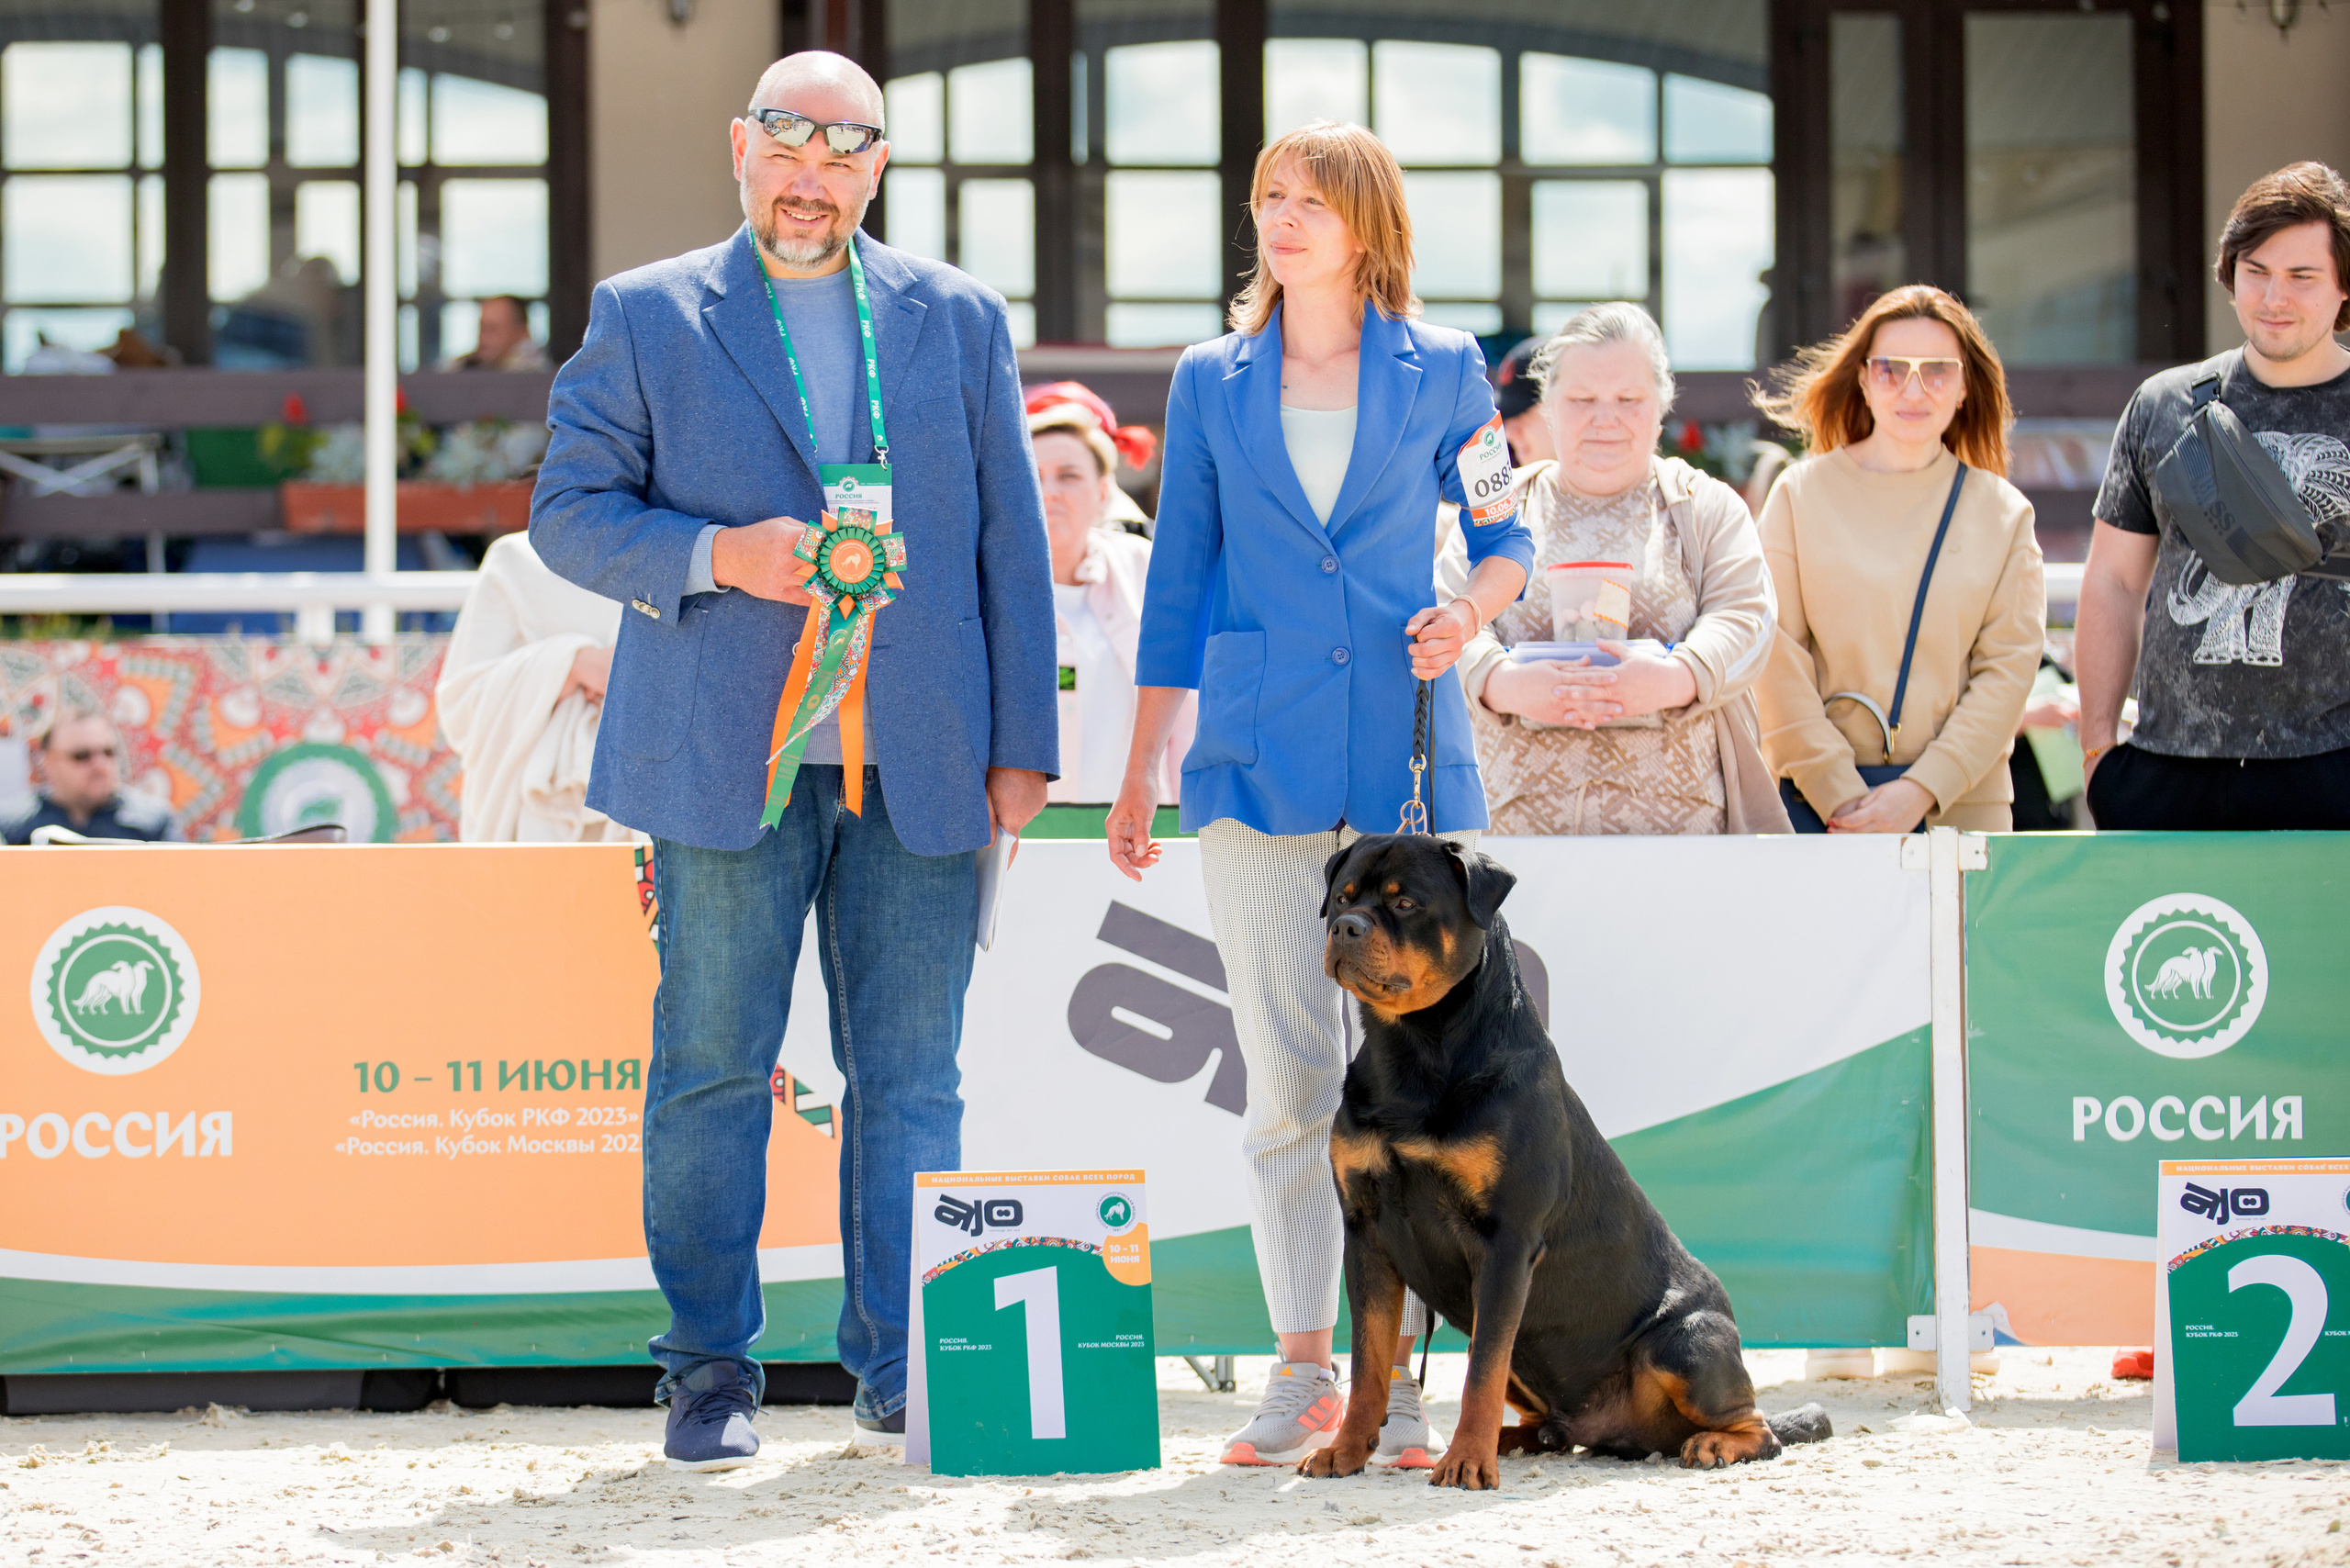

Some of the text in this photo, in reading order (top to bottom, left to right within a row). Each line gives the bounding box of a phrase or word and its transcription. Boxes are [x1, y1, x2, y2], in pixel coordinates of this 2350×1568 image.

[856, 283, 866, 300] РКФ
[861, 319, 871, 338] РКФ
[867, 358, 877, 378] РКФ
[871, 399, 880, 420] РКФ
[353, 1061, 400, 1092] 10
[446, 1060, 482, 1092] 11
[498, 1058, 641, 1092] ИЮНЯ
[349, 1106, 639, 1132] «Россия. Кубок РКФ 2023»
[2073, 1094, 2304, 1141] РОССИЯ
[0, 1111, 232, 1159] РОССИЯ
[335, 1137, 429, 1156] «Россия.
[435, 1135, 501, 1159] Кубок
[508, 1135, 595, 1154] Москвы
[1005, 1174, 1050, 1182] ВЫСТАВКИ
[1106, 1172, 1136, 1182] ПОРОД
[1109, 1245, 1121, 1253] 10
[1129, 1244, 1139, 1252] 11
[1110, 1255, 1140, 1263] ИЮНЯ
[2228, 1254, 2336, 1427] 2
[994, 1265, 1066, 1439] 1
